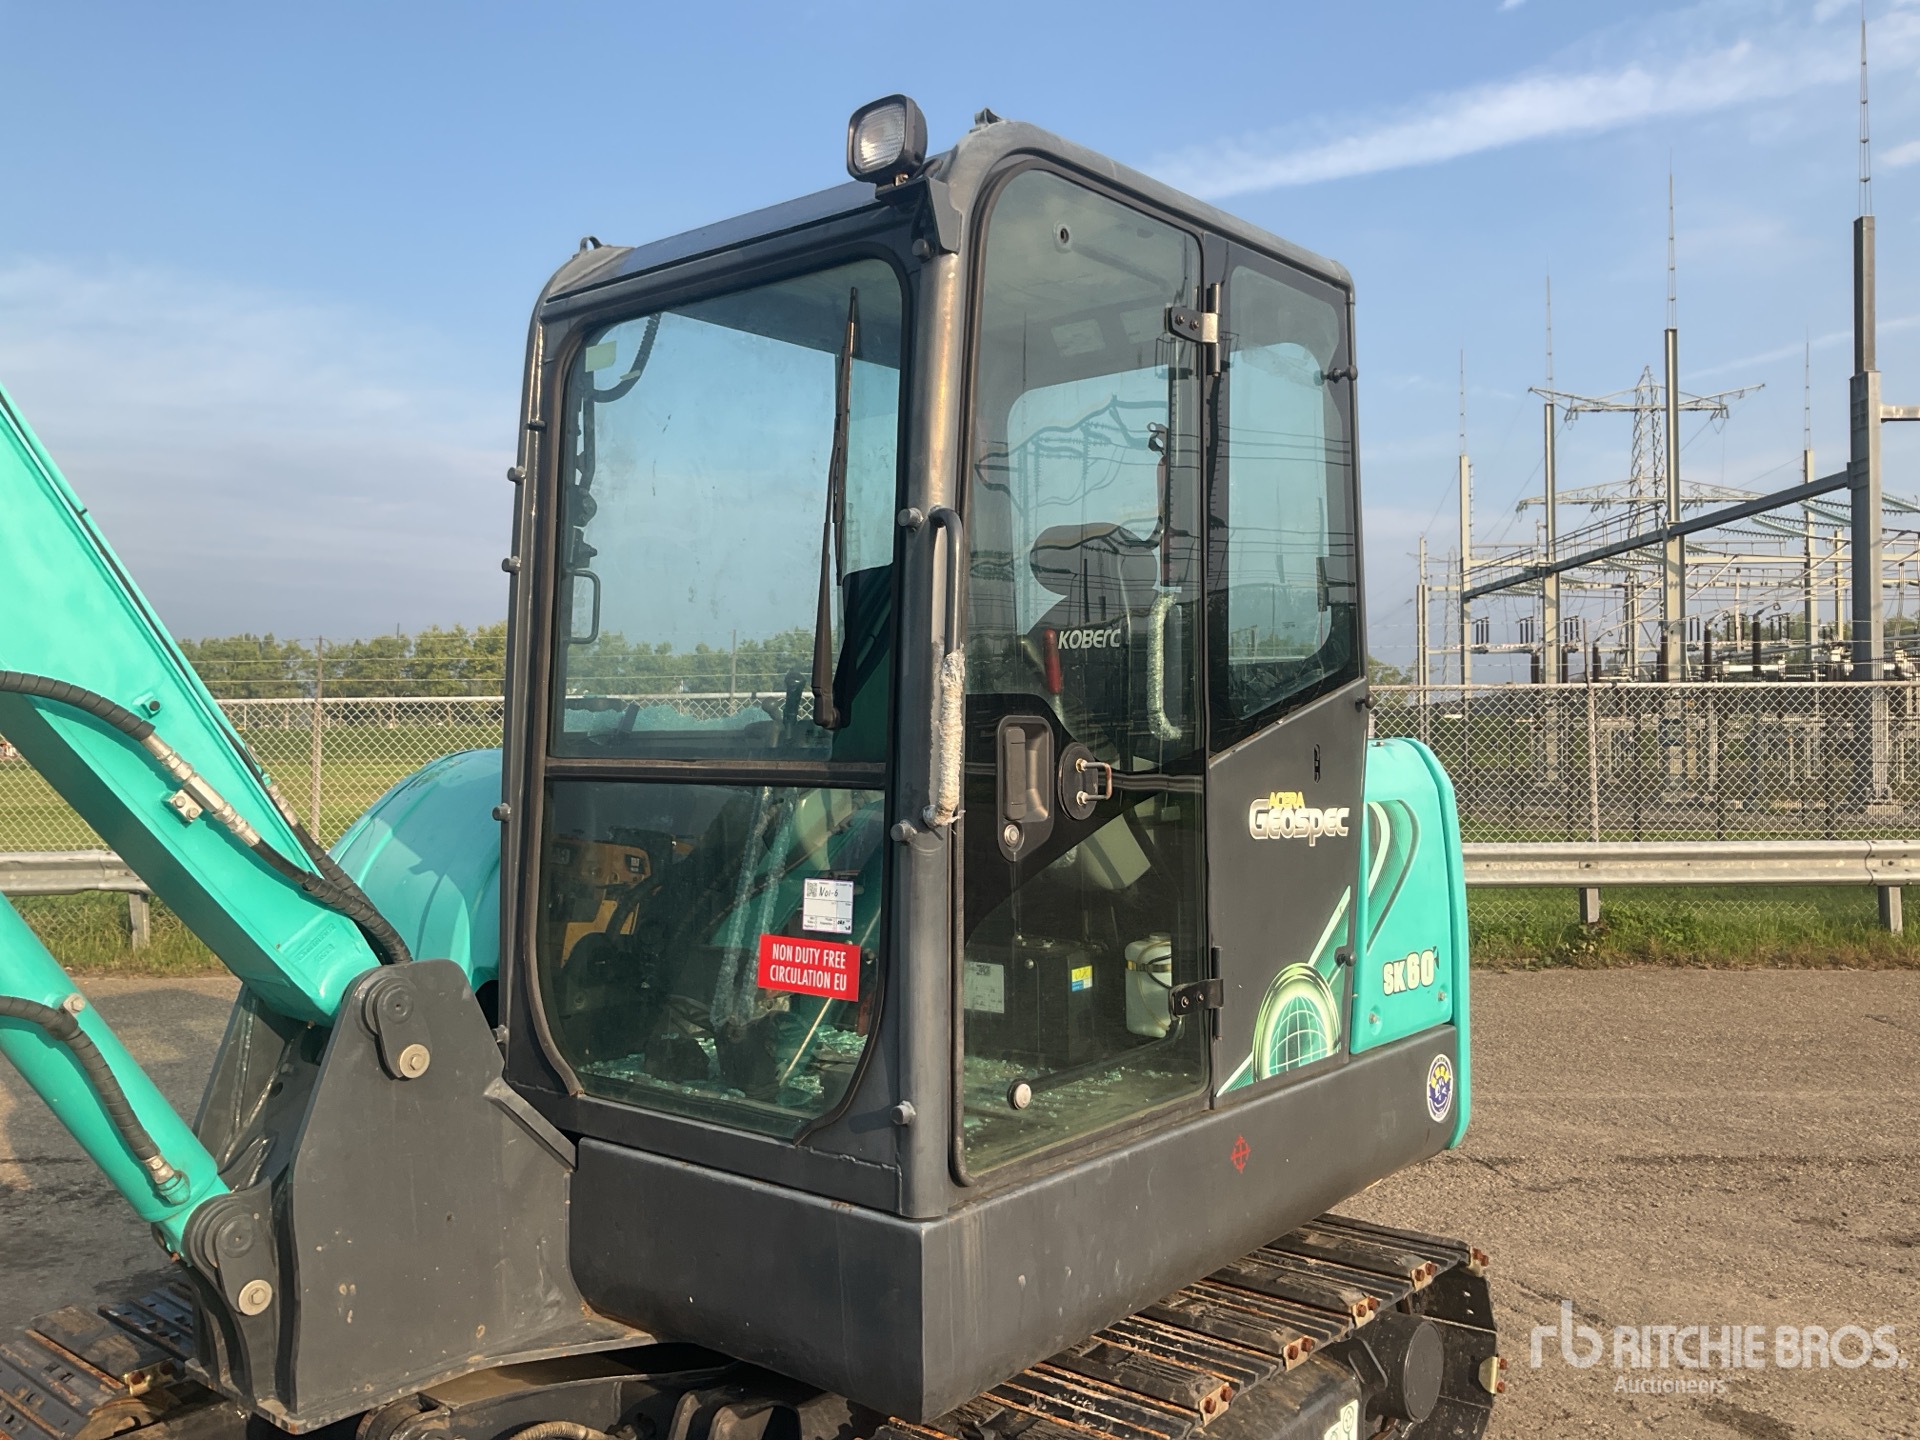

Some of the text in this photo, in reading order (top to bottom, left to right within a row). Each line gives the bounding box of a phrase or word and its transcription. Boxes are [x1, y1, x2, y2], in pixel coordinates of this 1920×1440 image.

[1268, 791, 1305, 810] ACERA
[772, 943, 847, 969] NON DUTY FREE
[769, 964, 847, 991] CIRCULATION EU
[1383, 949, 1435, 996] SK60
